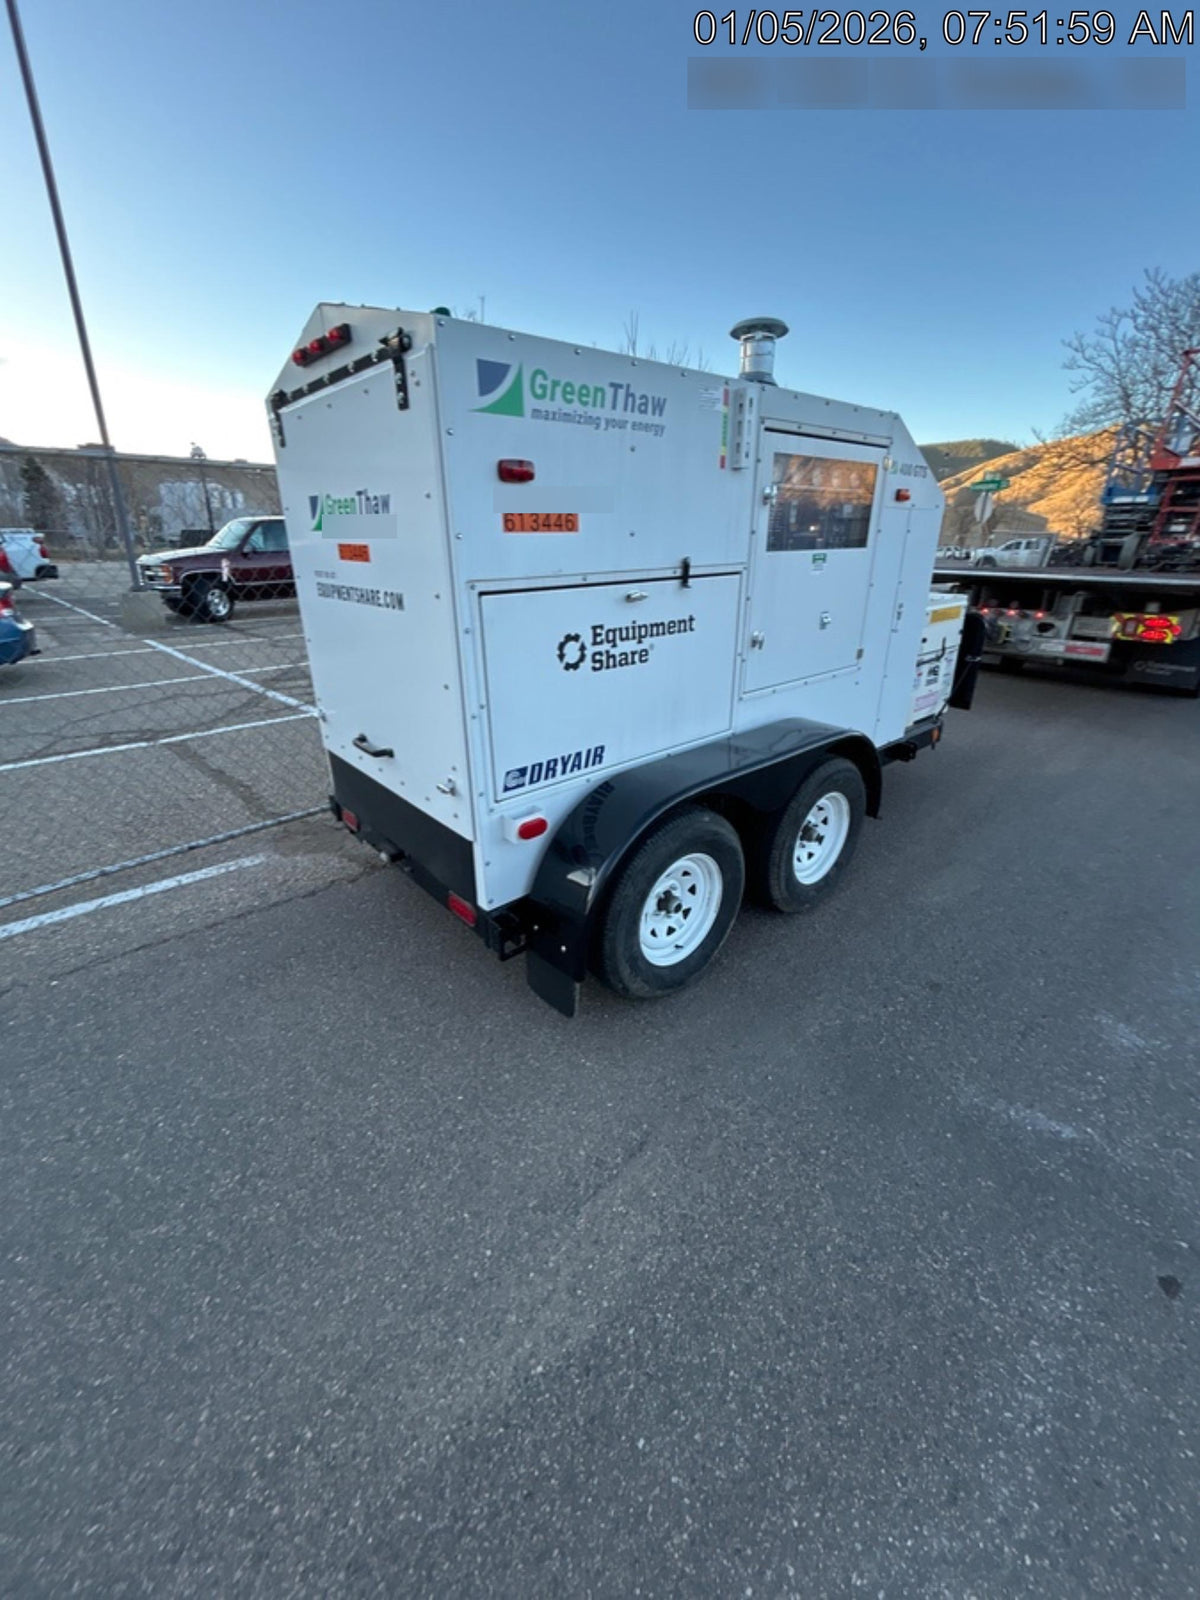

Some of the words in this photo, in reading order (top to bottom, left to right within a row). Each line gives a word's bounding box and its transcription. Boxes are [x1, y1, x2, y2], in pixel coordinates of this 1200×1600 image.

[529, 368, 667, 417] GreenThaw
[531, 407, 600, 430] maximizing
[603, 416, 629, 431] your
[631, 420, 666, 437] energy
[504, 513, 577, 532] 613446
[591, 614, 696, 648] Equipment
[527, 745, 605, 786] DRYAIR
